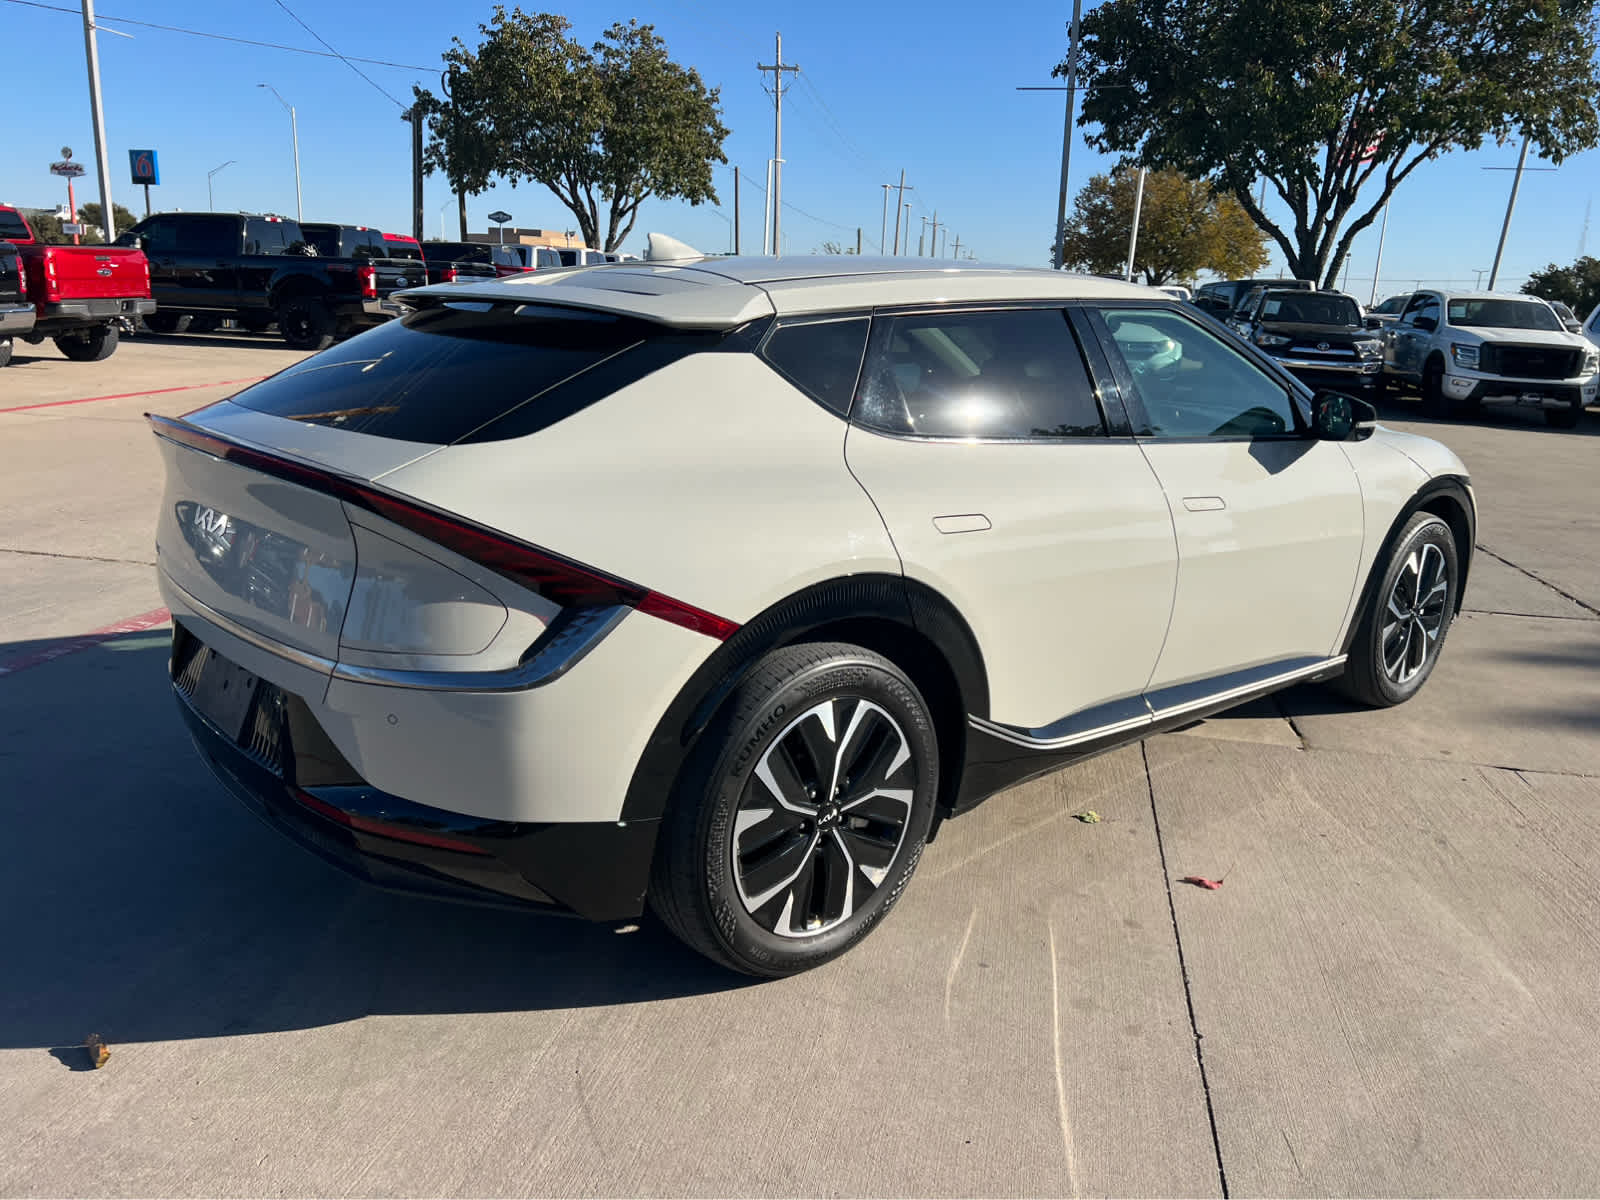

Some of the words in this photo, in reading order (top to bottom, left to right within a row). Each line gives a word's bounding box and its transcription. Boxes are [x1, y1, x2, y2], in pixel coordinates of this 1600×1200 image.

[136, 152, 152, 177] 6
[194, 504, 229, 537] KIA
[730, 703, 786, 778] KUMHO
